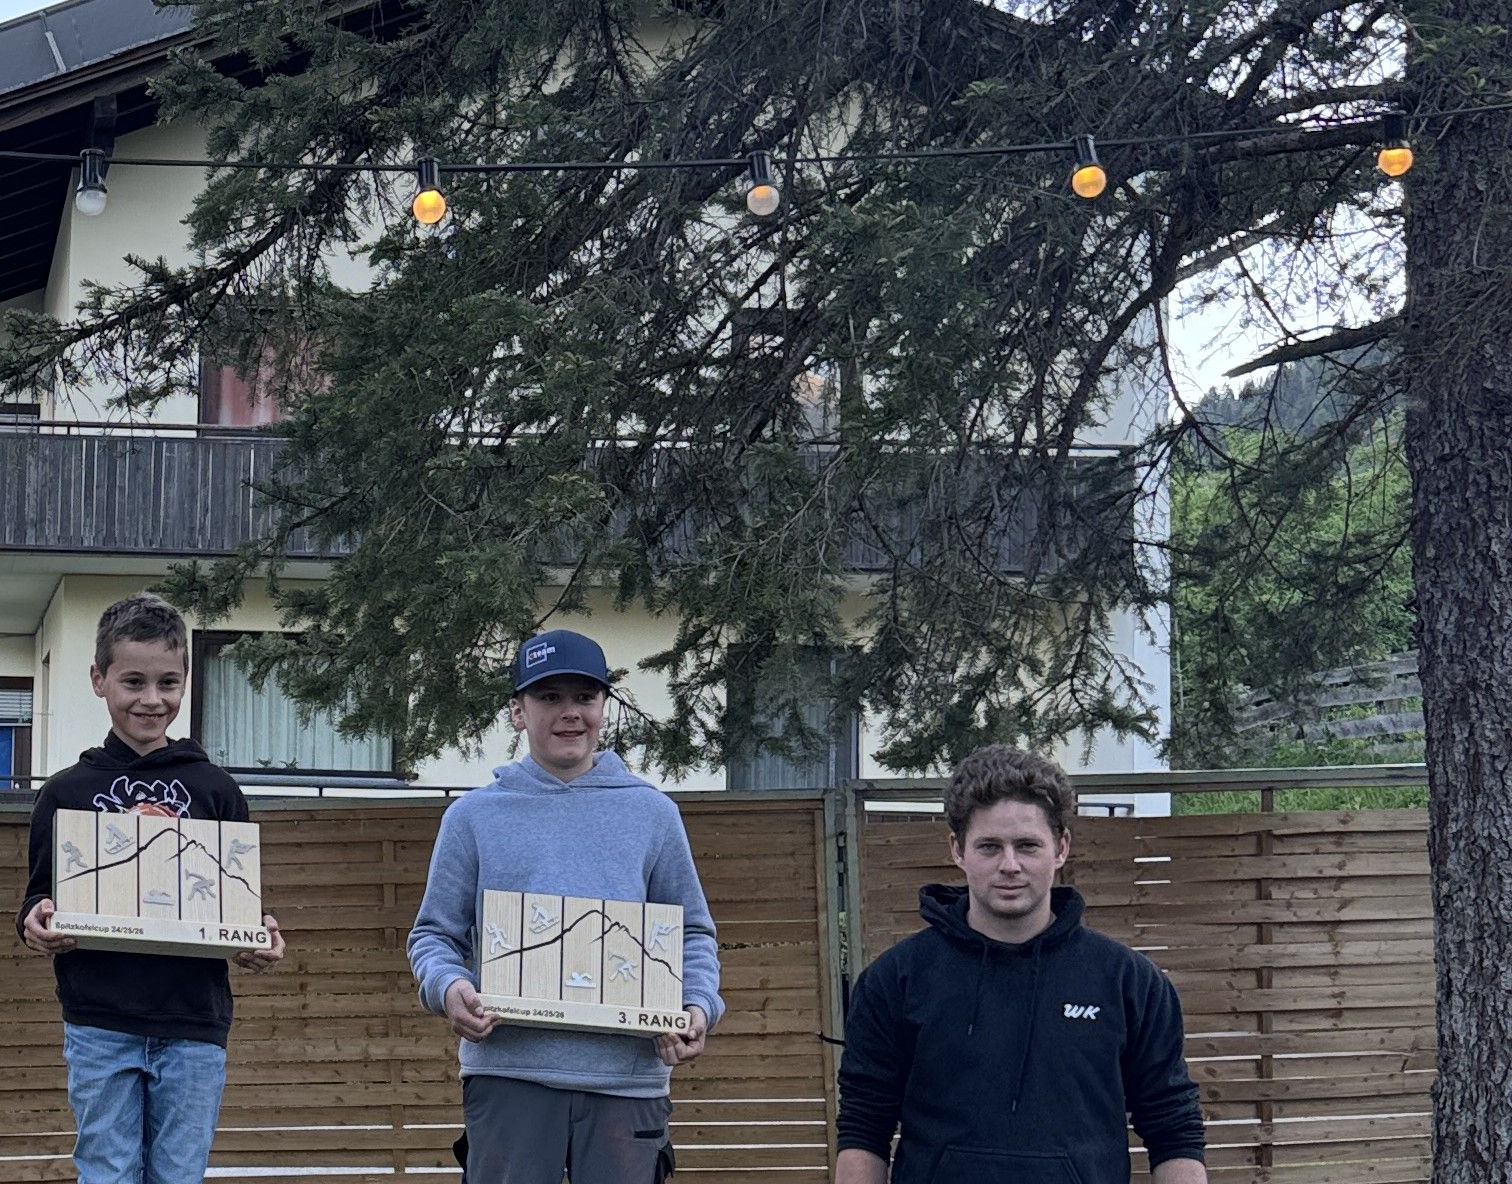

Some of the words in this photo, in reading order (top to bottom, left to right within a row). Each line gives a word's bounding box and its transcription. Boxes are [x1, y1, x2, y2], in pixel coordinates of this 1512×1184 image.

[55, 921, 110, 933] Spitzkofelcup
[111, 925, 144, 935] 24/25/26
[199, 927, 213, 941] 1.
[219, 928, 267, 944] RANG
[483, 1005, 530, 1017] pitzkofelcup
[532, 1008, 565, 1019] 24/25/26
[619, 1011, 632, 1026] 3.
[638, 1013, 686, 1029] RANG
[1064, 1003, 1100, 1020] WK
